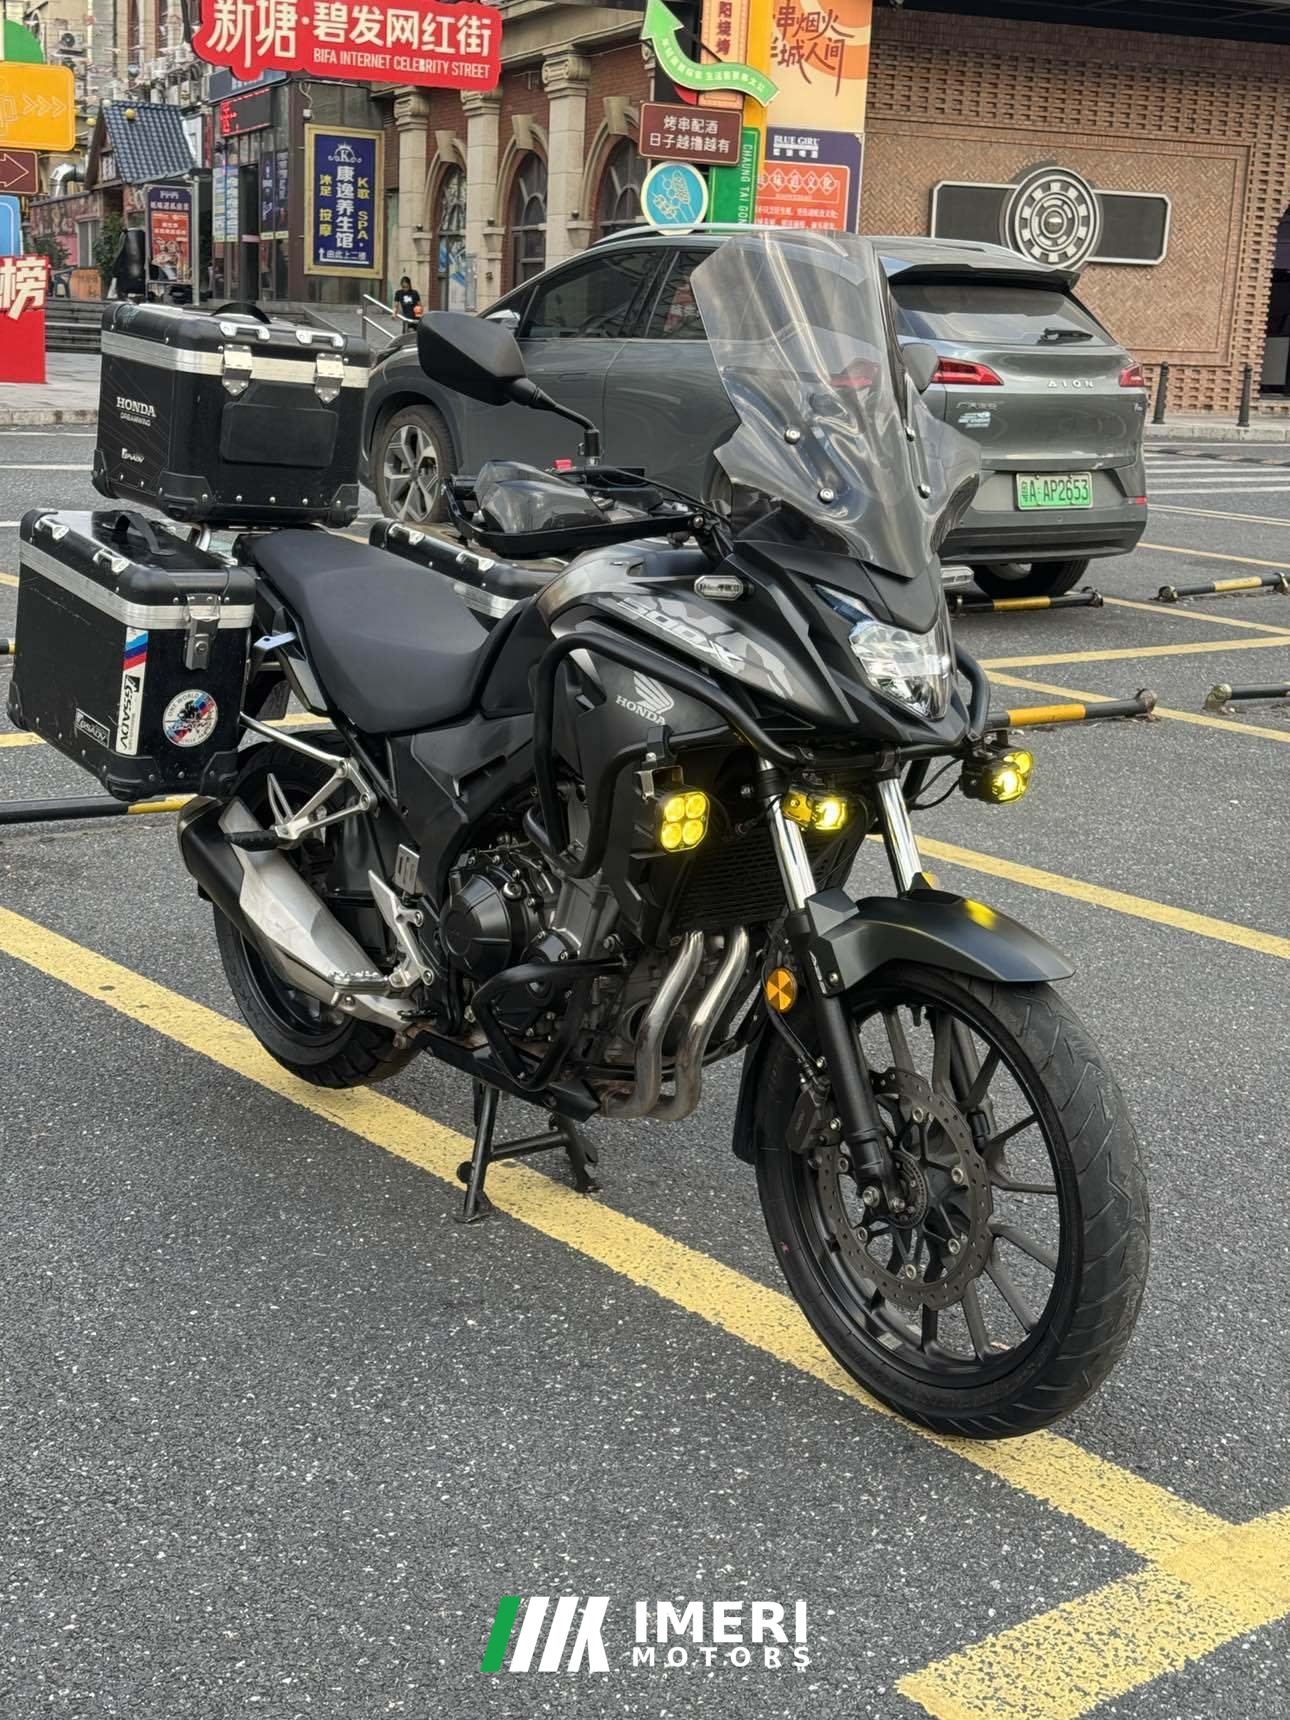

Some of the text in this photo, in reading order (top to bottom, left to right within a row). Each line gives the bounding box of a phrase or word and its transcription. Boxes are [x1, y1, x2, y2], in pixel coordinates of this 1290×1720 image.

[313, 47, 491, 79] BIFA INTERNET CELEBRITY STREET
[663, 115, 719, 134] 烤串配酒
[649, 132, 731, 154] 日子越撸越有
[773, 134, 819, 146] BLUE GIRL
[741, 144, 753, 182] CHAUNG
[738, 187, 750, 202] TAI
[335, 165, 355, 249] 康逸养生馆
[1047, 379, 1094, 388] AION
[116, 396, 157, 418] HONDA
[1043, 478, 1089, 501] AP2653
[616, 597, 744, 669] 500X
[615, 695, 666, 726] HONDA
